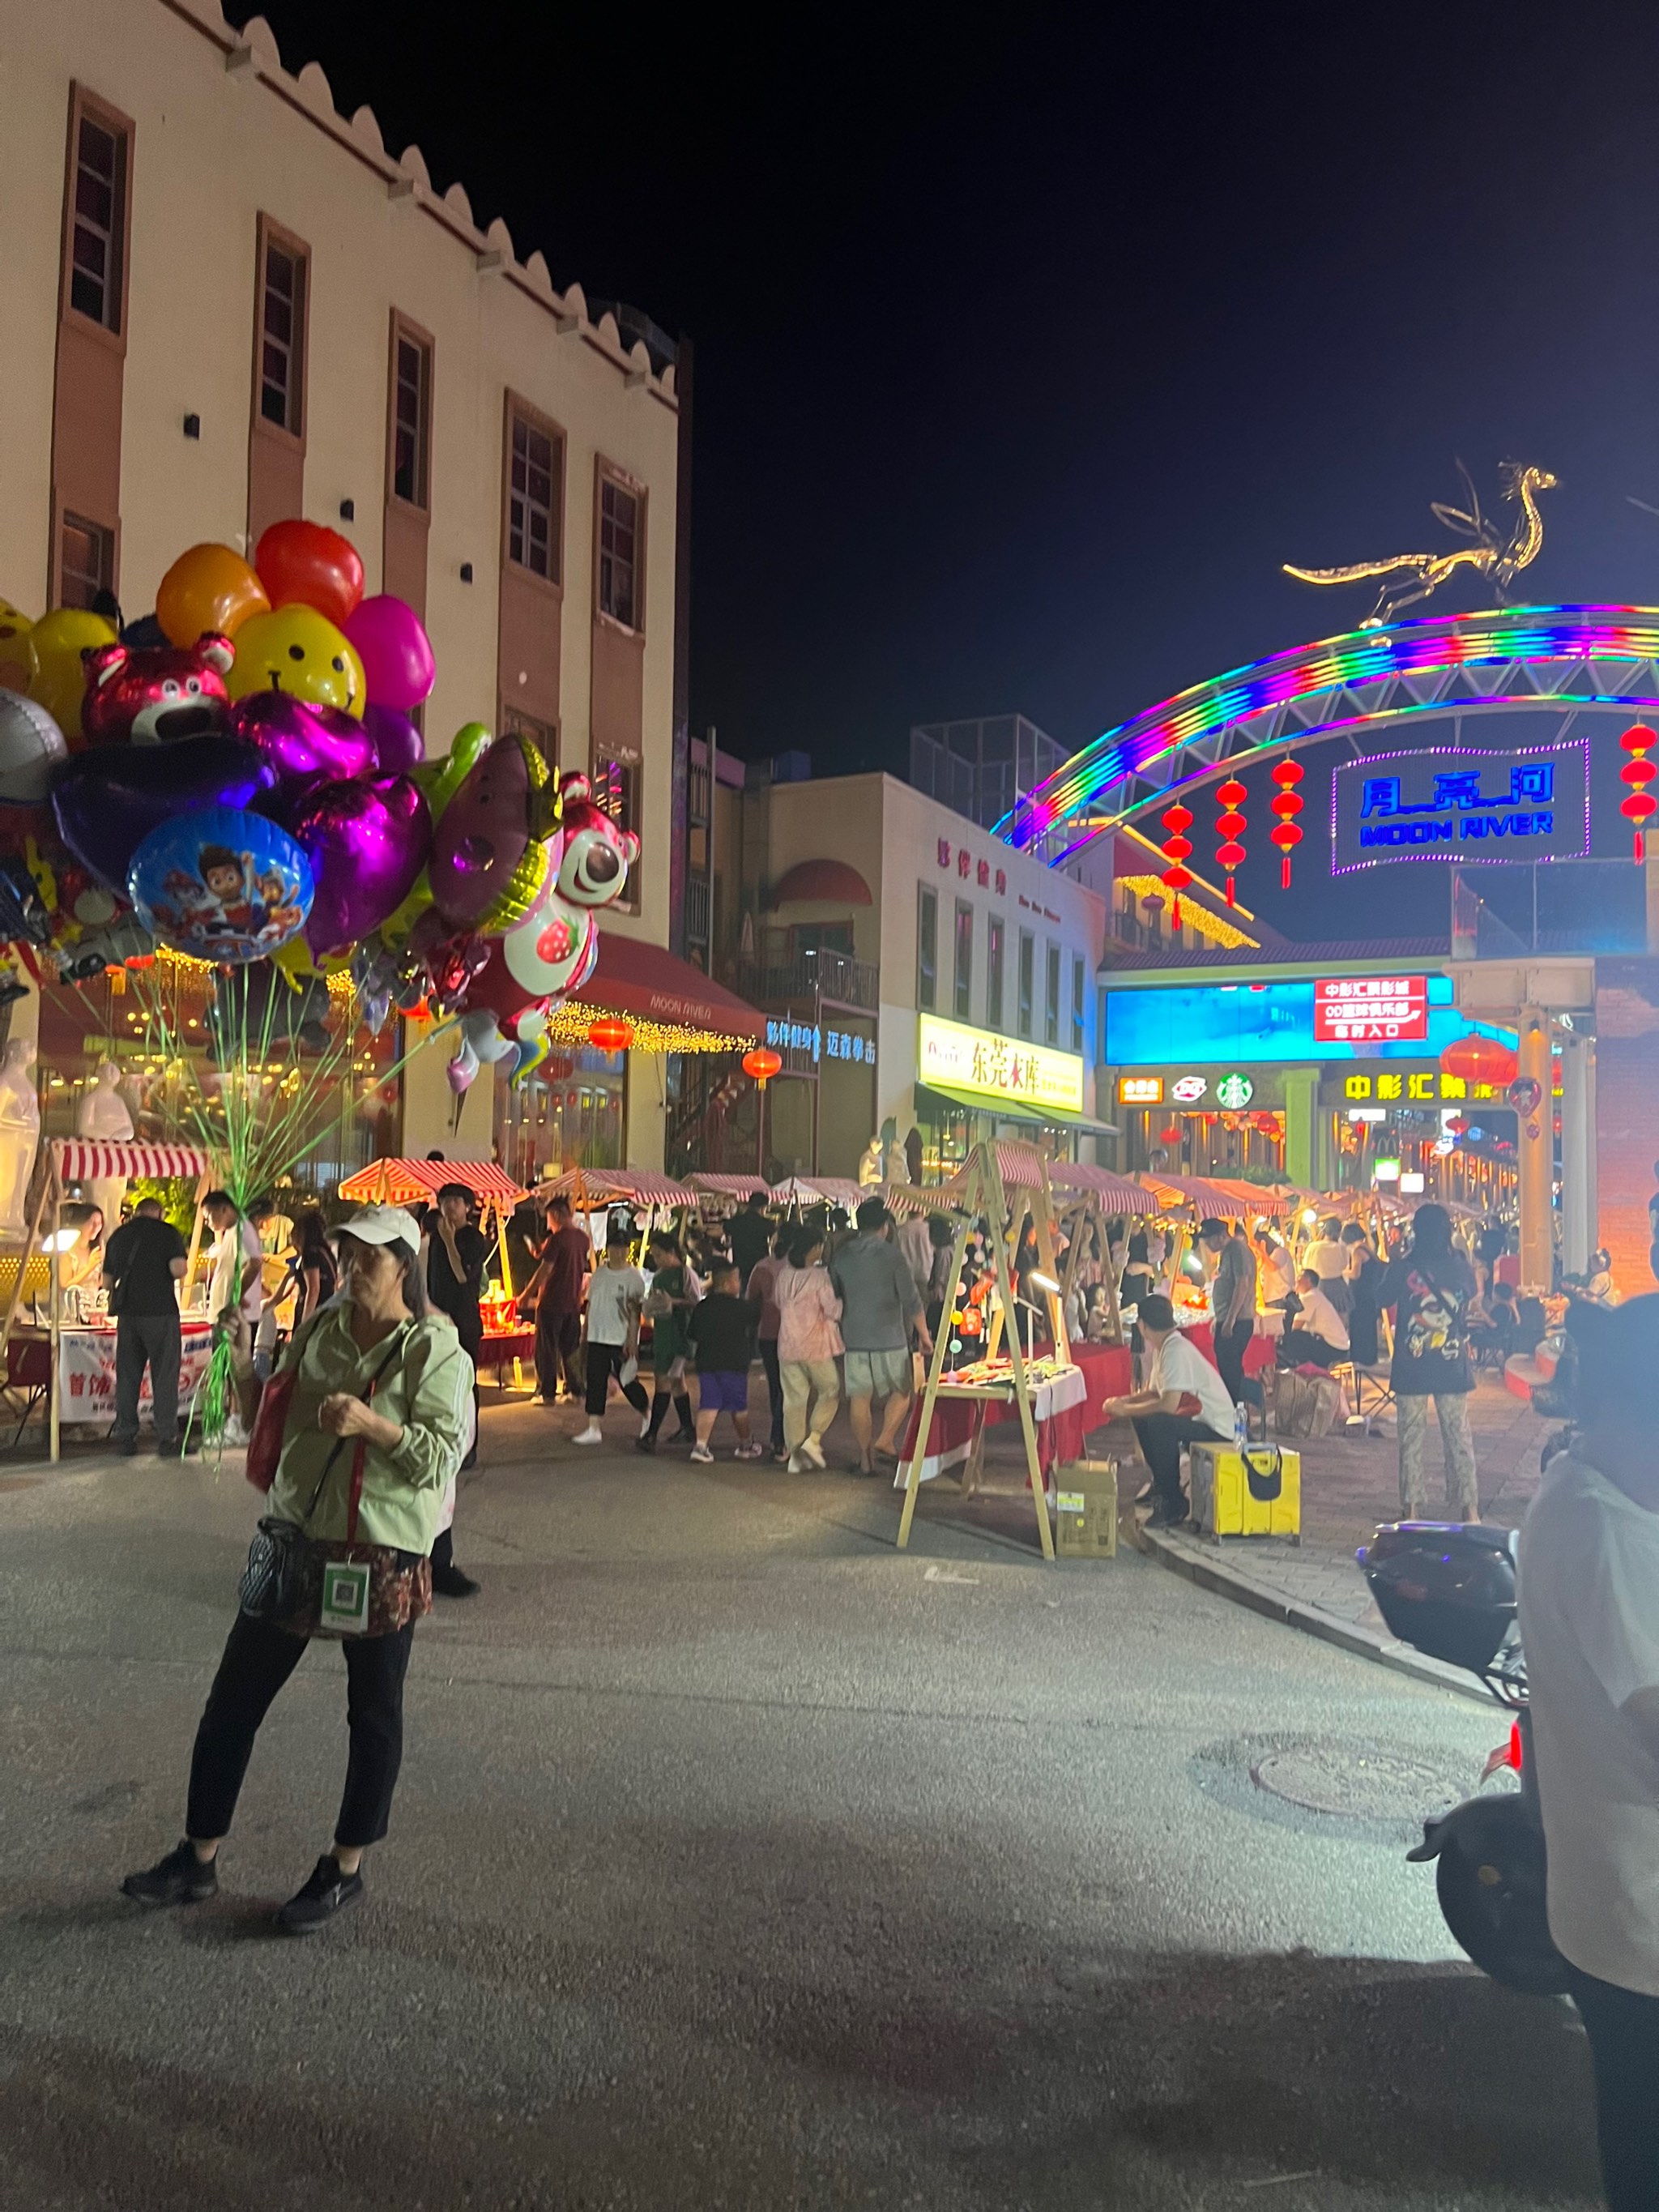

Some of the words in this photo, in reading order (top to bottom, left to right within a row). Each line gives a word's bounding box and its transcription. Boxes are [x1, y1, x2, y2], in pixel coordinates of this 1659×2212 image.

[1361, 762, 1555, 818] 月亮河
[1360, 820, 1452, 848] MOON
[1460, 811, 1554, 841] RIVER
[650, 994, 681, 1014] MOON
